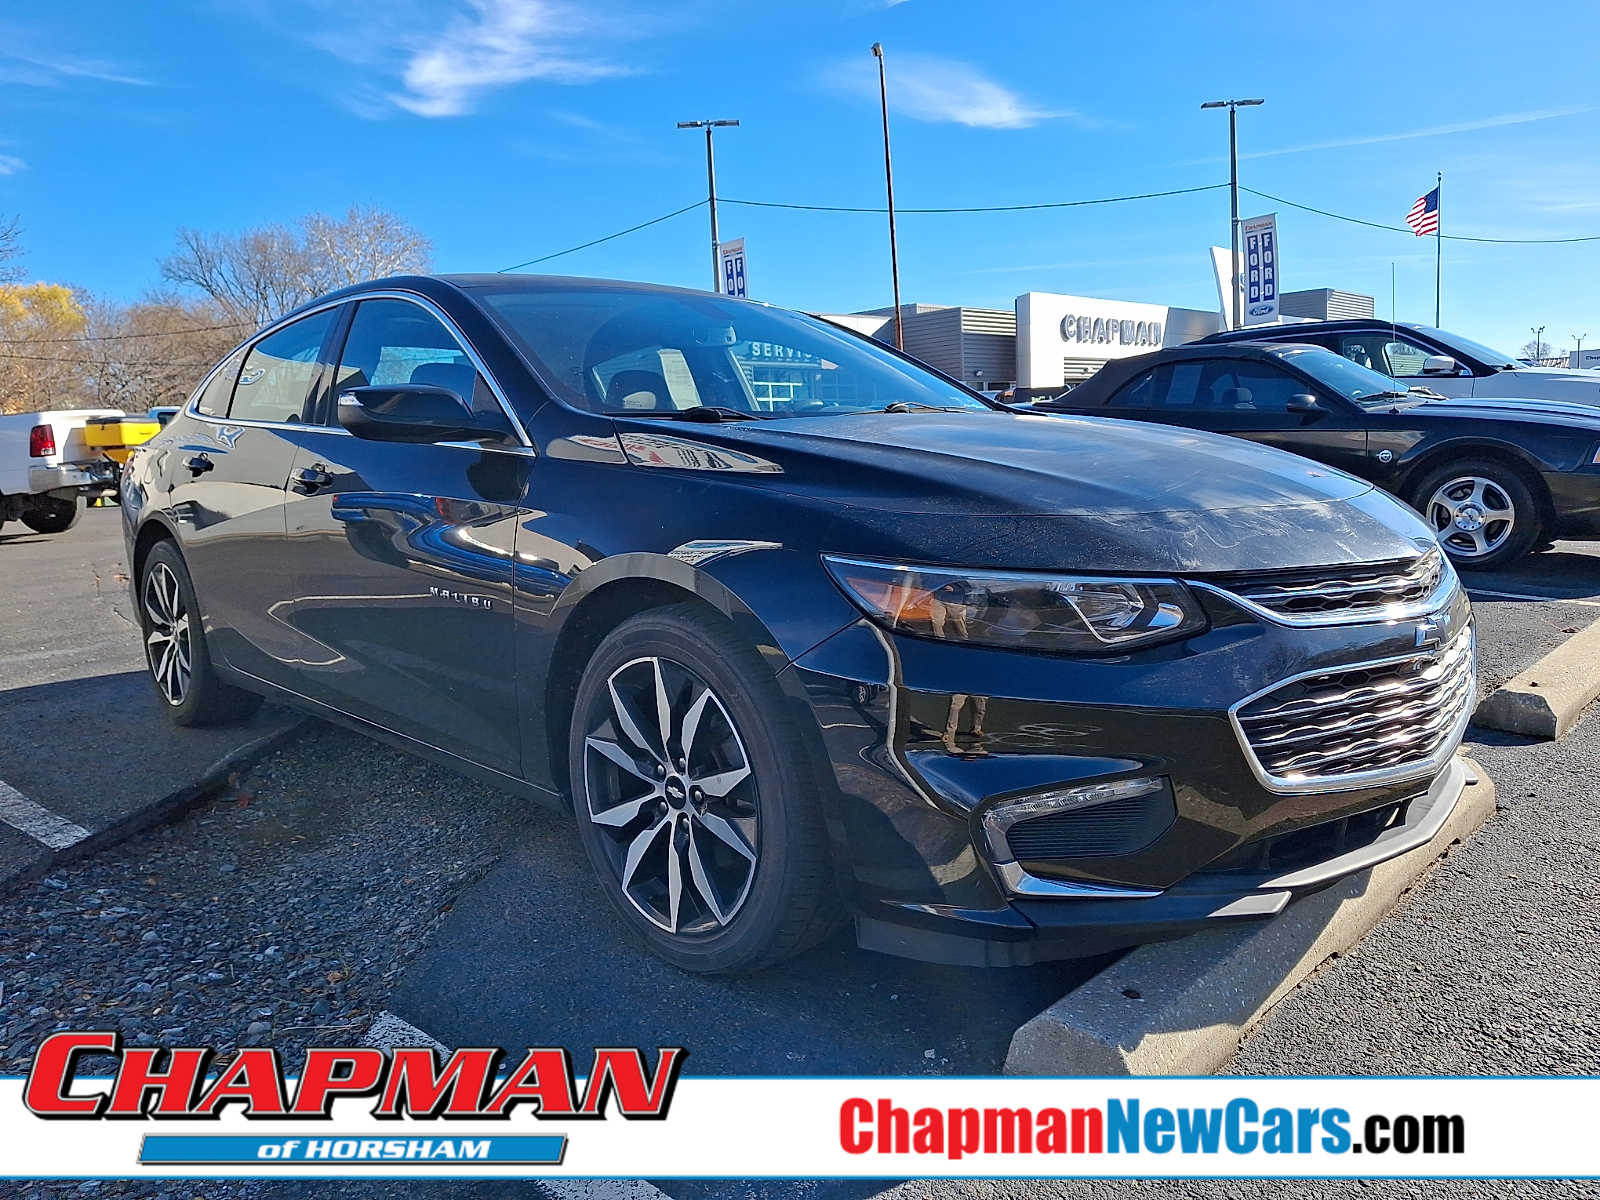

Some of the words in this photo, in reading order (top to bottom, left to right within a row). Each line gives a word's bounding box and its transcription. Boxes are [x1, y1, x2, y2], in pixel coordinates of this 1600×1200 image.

[725, 261, 734, 292] FO
[736, 259, 745, 296] FO
[1249, 236, 1259, 299] FORD
[1262, 234, 1274, 297] FORD
[1060, 314, 1161, 346] CHAPMAN
[429, 586, 492, 609] MALIBU
